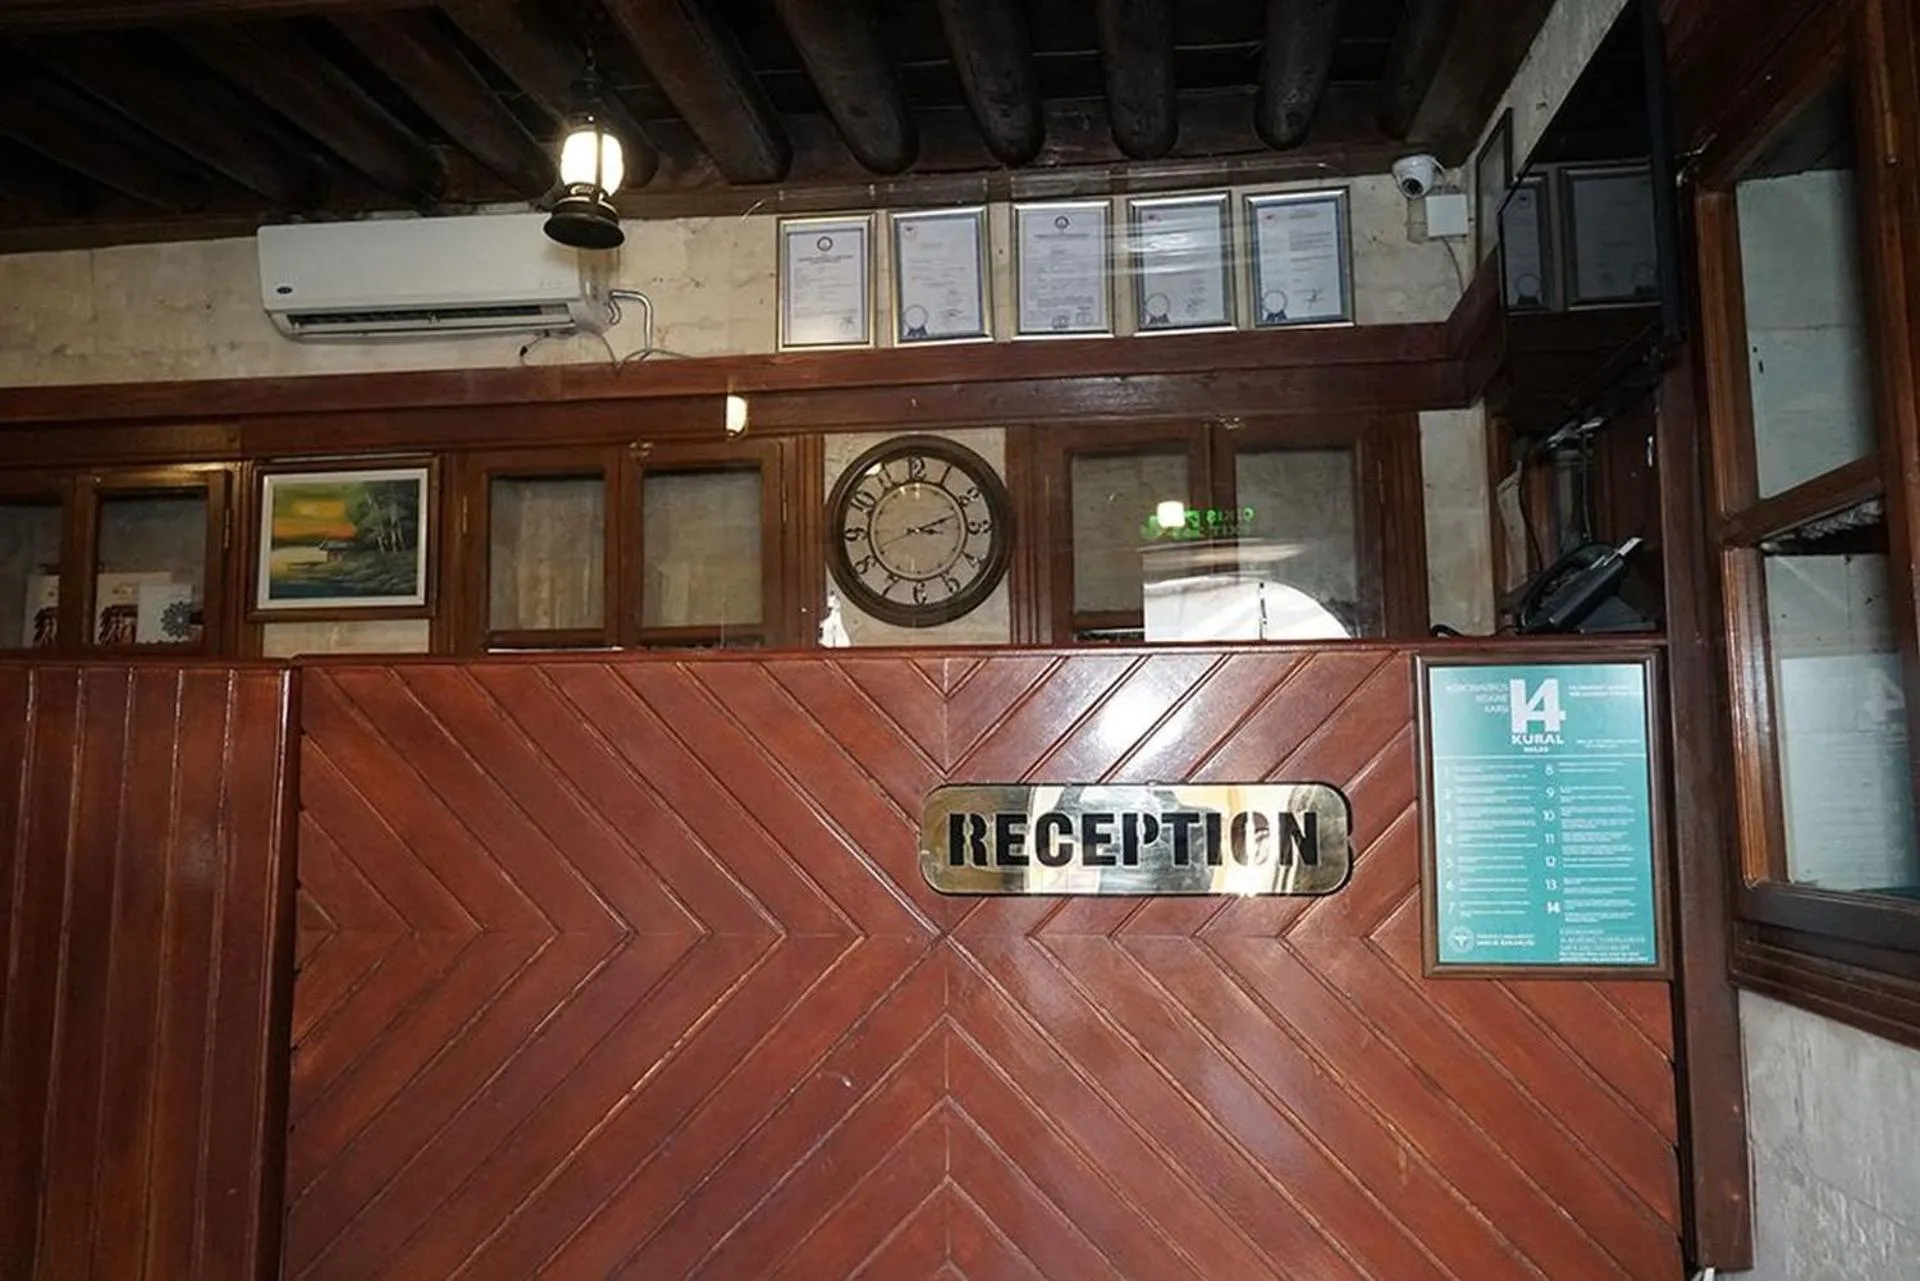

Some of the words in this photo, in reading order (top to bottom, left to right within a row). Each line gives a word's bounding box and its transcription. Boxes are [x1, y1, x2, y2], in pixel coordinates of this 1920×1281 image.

[1509, 678, 1566, 733] 14
[1511, 733, 1564, 745] KURAL
[948, 811, 1320, 867] RECEPTION
